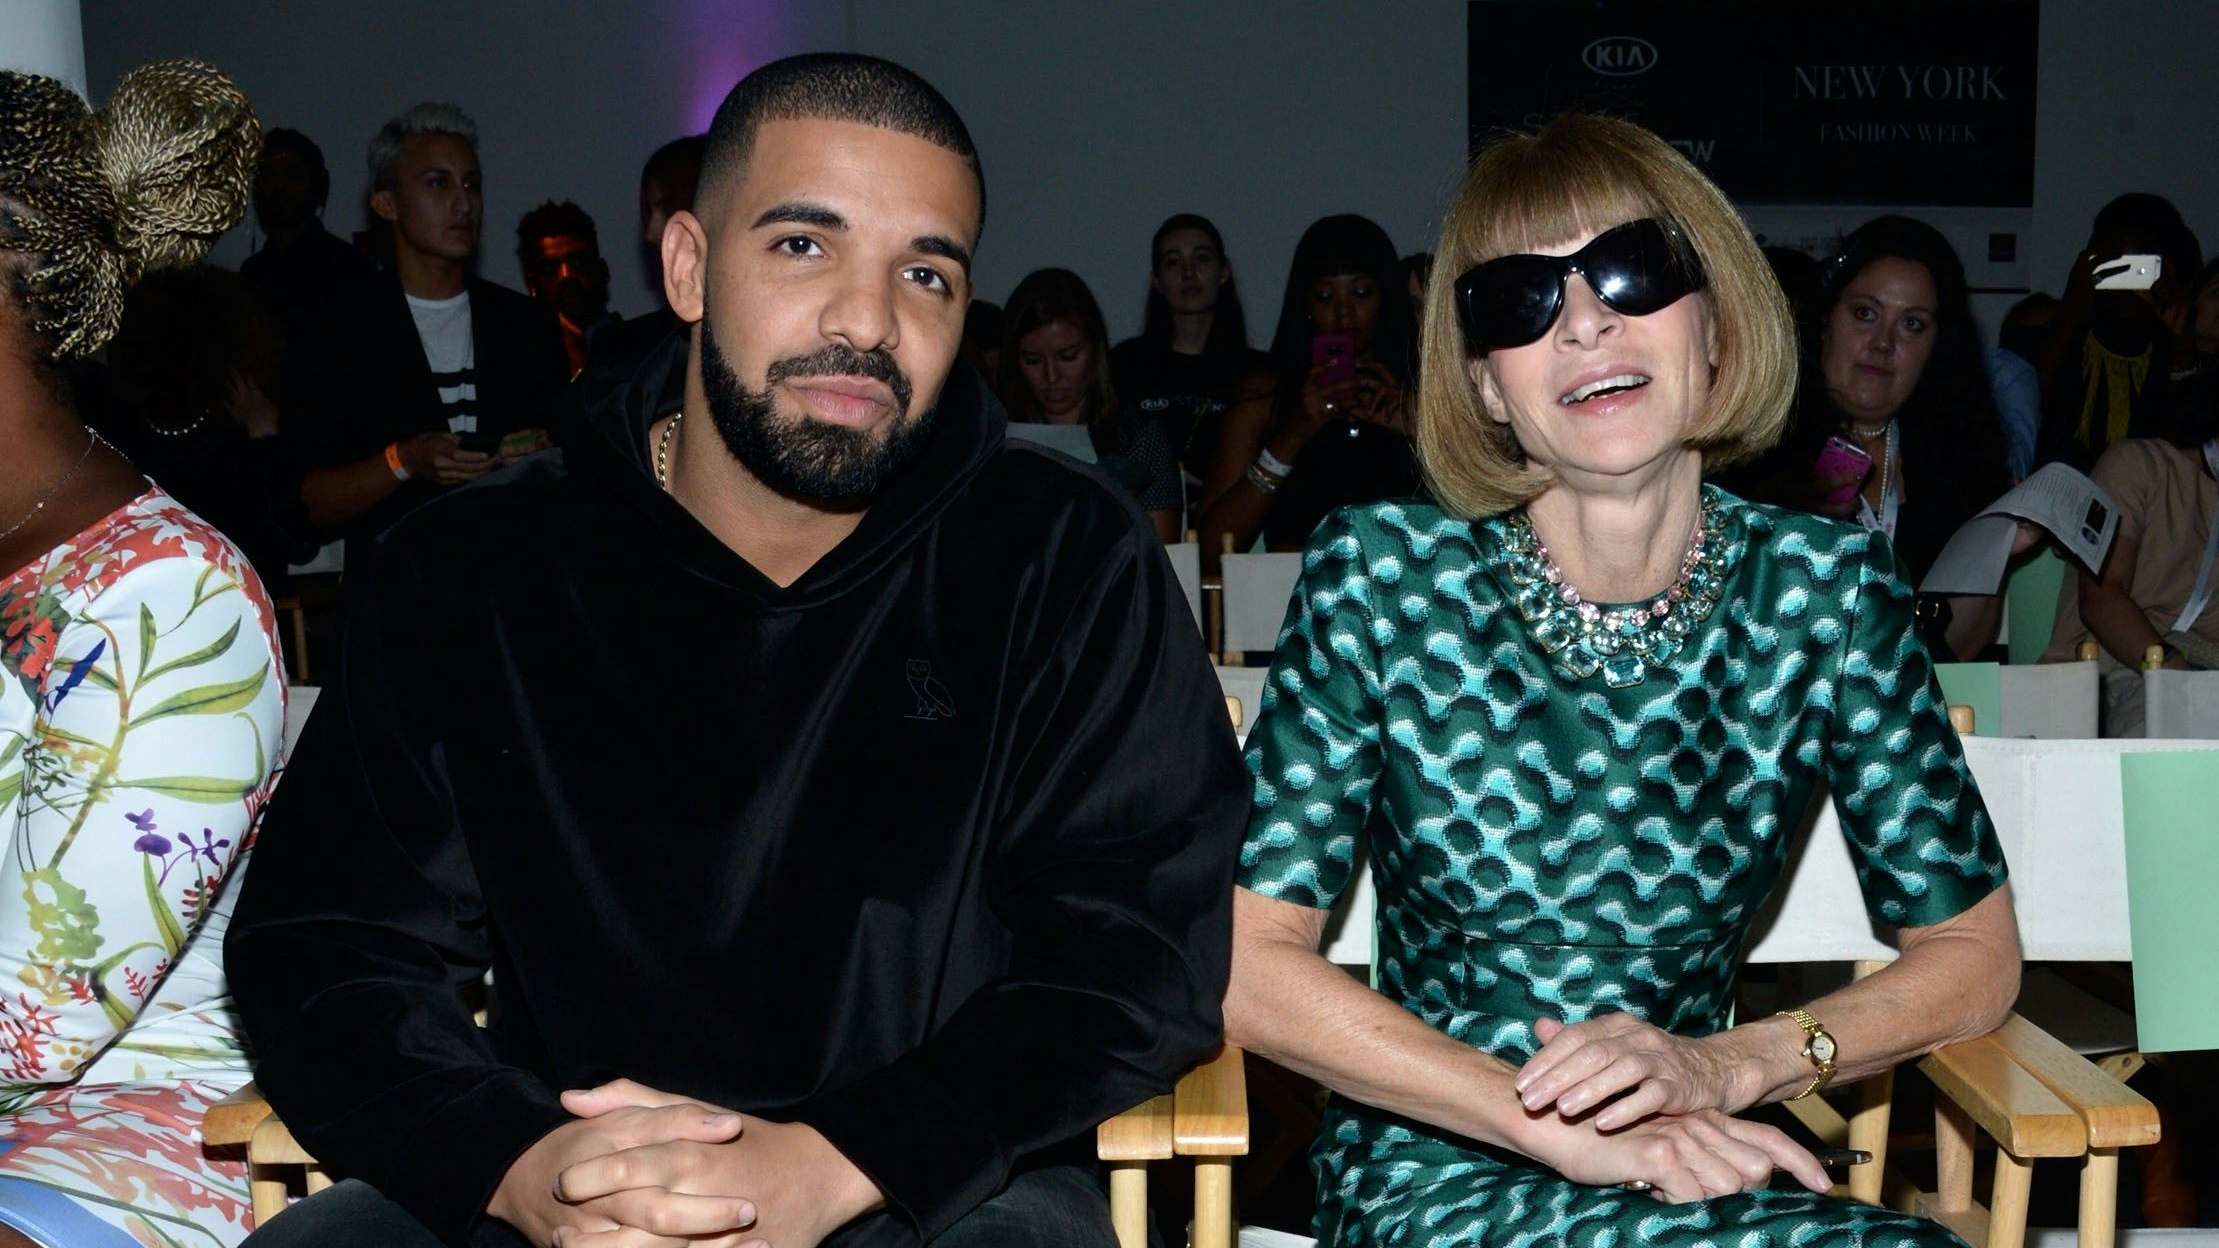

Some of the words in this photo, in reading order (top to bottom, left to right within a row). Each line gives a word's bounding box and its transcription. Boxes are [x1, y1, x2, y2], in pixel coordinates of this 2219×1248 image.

[1594, 43, 1647, 68] KIA
[1793, 65, 1887, 99] NEW
[1896, 65, 2009, 100] YORK
[1819, 122, 1912, 143] FASHION
[1917, 122, 1979, 143] WEEK
